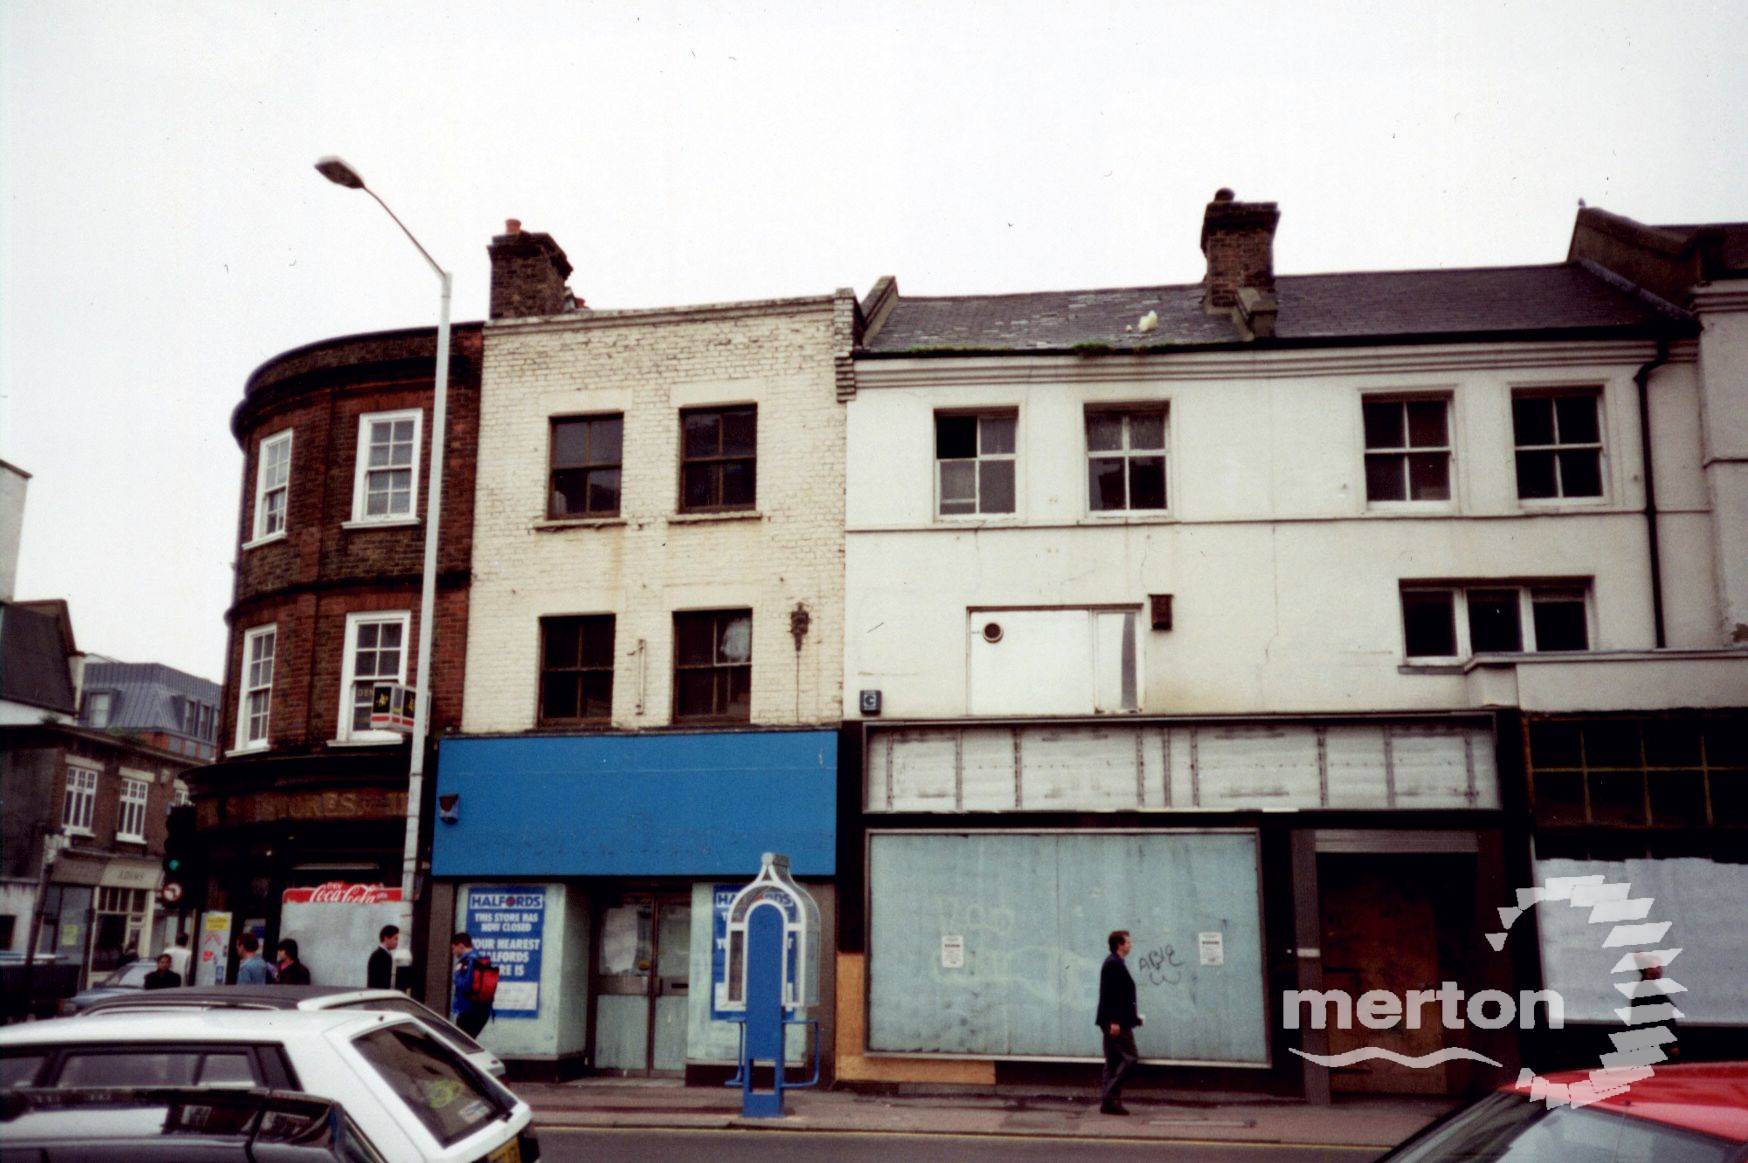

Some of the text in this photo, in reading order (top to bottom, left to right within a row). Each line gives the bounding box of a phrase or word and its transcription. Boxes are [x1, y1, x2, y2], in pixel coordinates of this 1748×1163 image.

[471, 896, 542, 907] HALFORDS
[475, 912, 539, 922] THIS STORE HAS
[481, 922, 532, 933] NOW CLOSED
[497, 938, 540, 950] NEAREST
